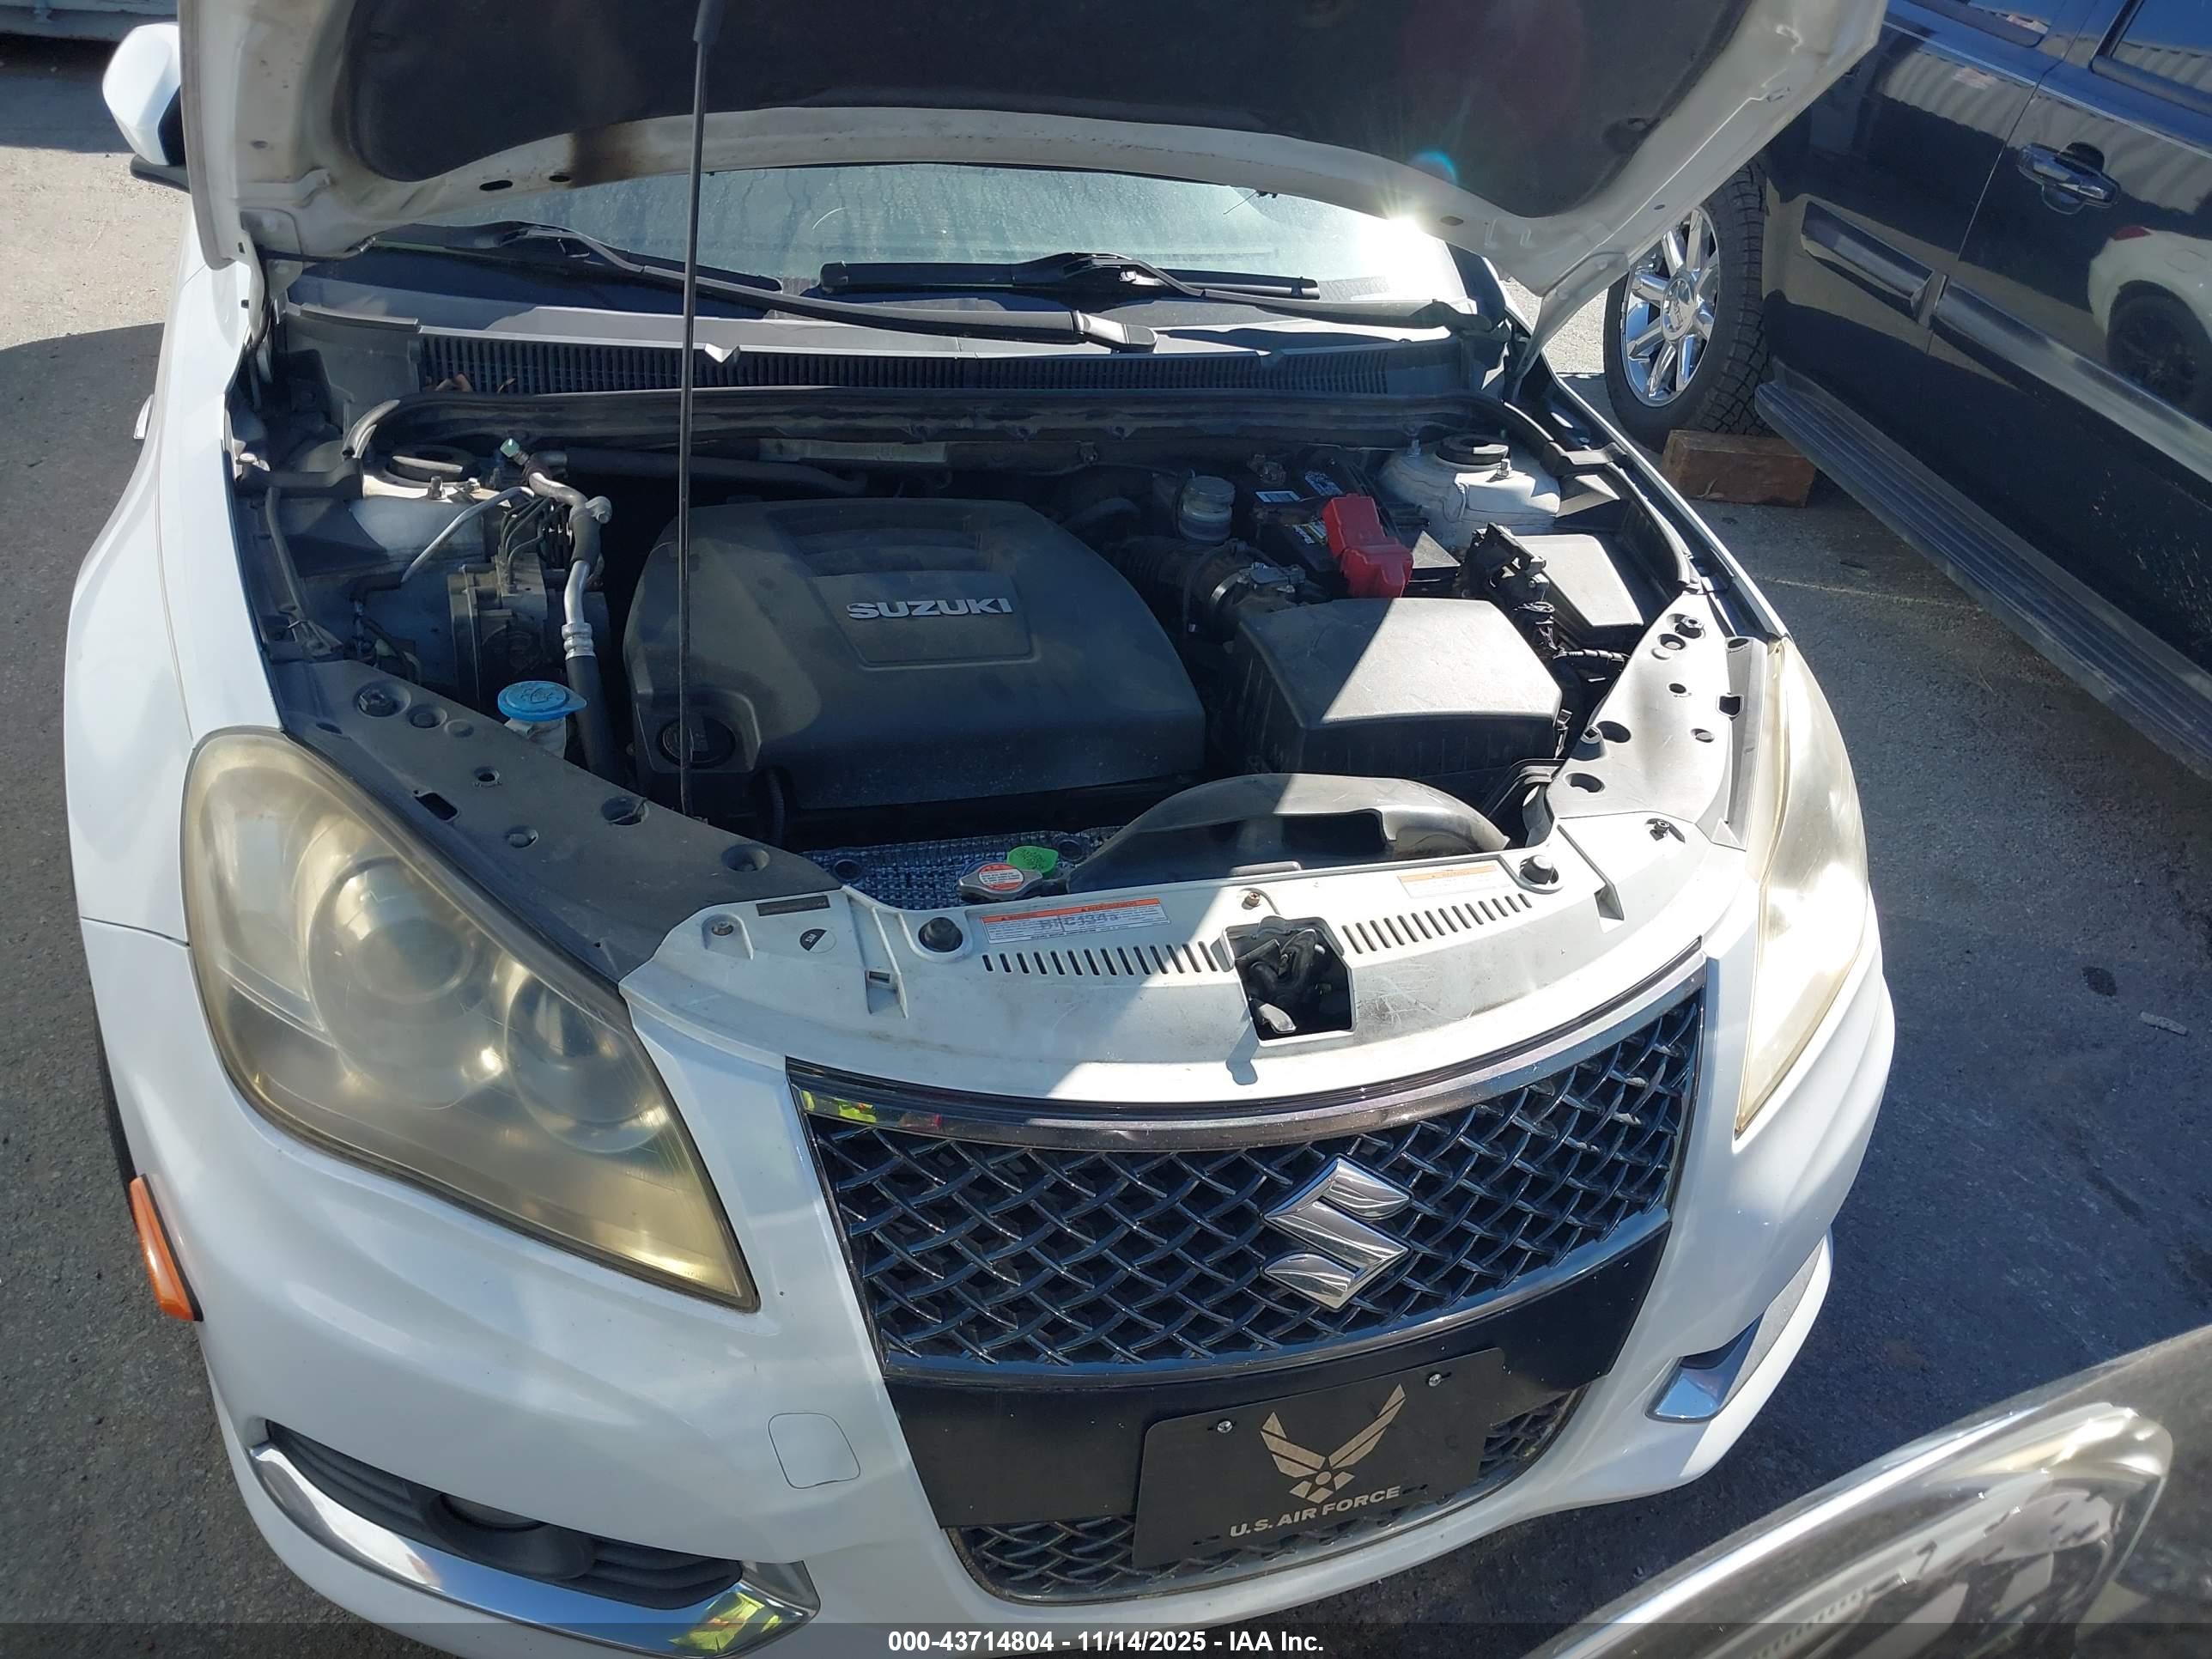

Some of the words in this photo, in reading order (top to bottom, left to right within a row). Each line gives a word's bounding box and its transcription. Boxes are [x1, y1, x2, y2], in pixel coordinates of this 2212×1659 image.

[846, 598, 1013, 620] SUZUKI
[1230, 1518, 1273, 1537] U.S.
[1277, 1507, 1317, 1526] AIR
[1322, 1486, 1401, 1516] FORCE
